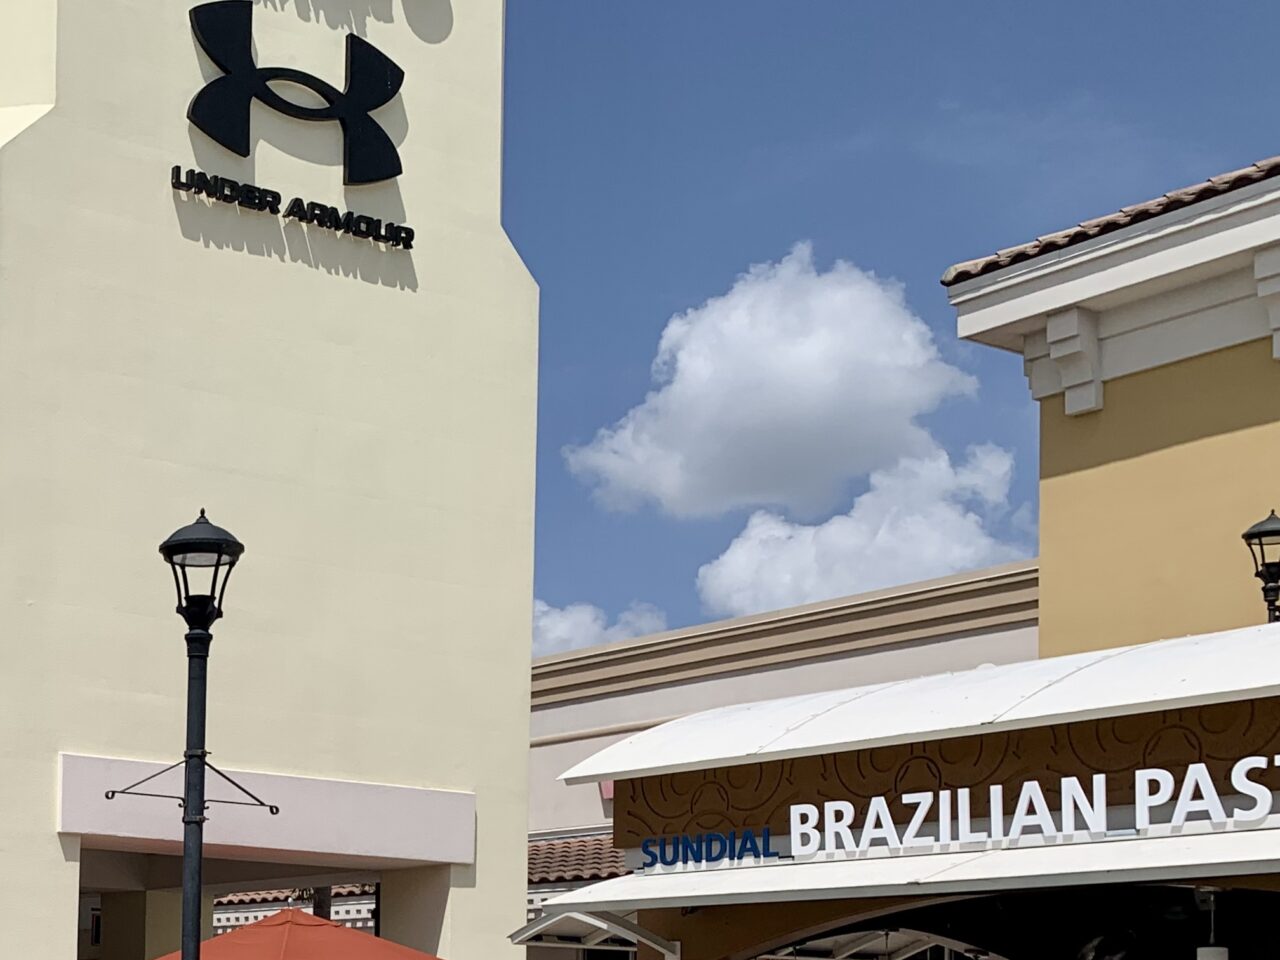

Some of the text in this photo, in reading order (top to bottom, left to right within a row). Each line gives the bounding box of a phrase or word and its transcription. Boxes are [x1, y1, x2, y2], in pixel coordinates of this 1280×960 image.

[172, 165, 415, 249] UNDER ARMOUR
[641, 755, 1280, 868] SUNDIAL BRAZILIAN PAS
